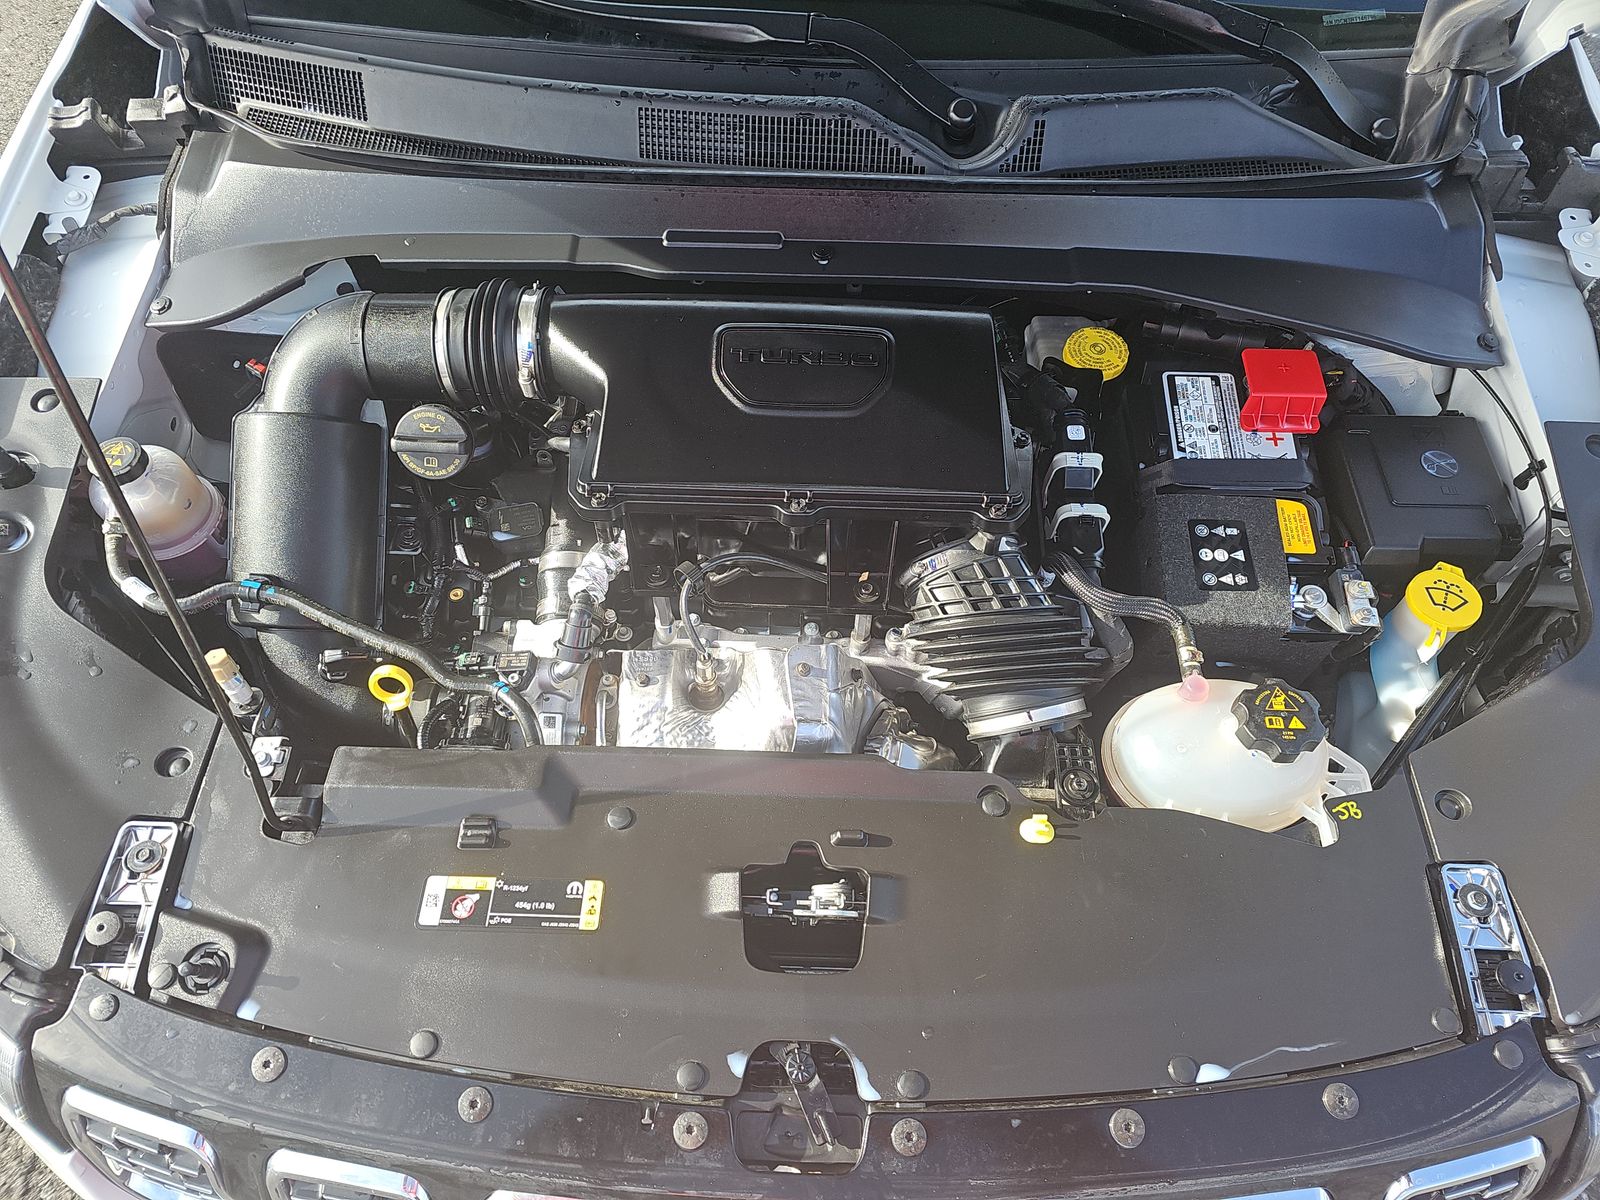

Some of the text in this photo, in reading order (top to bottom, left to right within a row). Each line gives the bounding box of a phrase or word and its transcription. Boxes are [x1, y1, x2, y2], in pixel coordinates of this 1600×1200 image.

[730, 347, 879, 367] TURBO
[413, 412, 446, 422] ENGINE OIL
[502, 884, 528, 892] R-1234yf
[514, 901, 532, 910] 454g
[532, 902, 545, 910] (1.0
